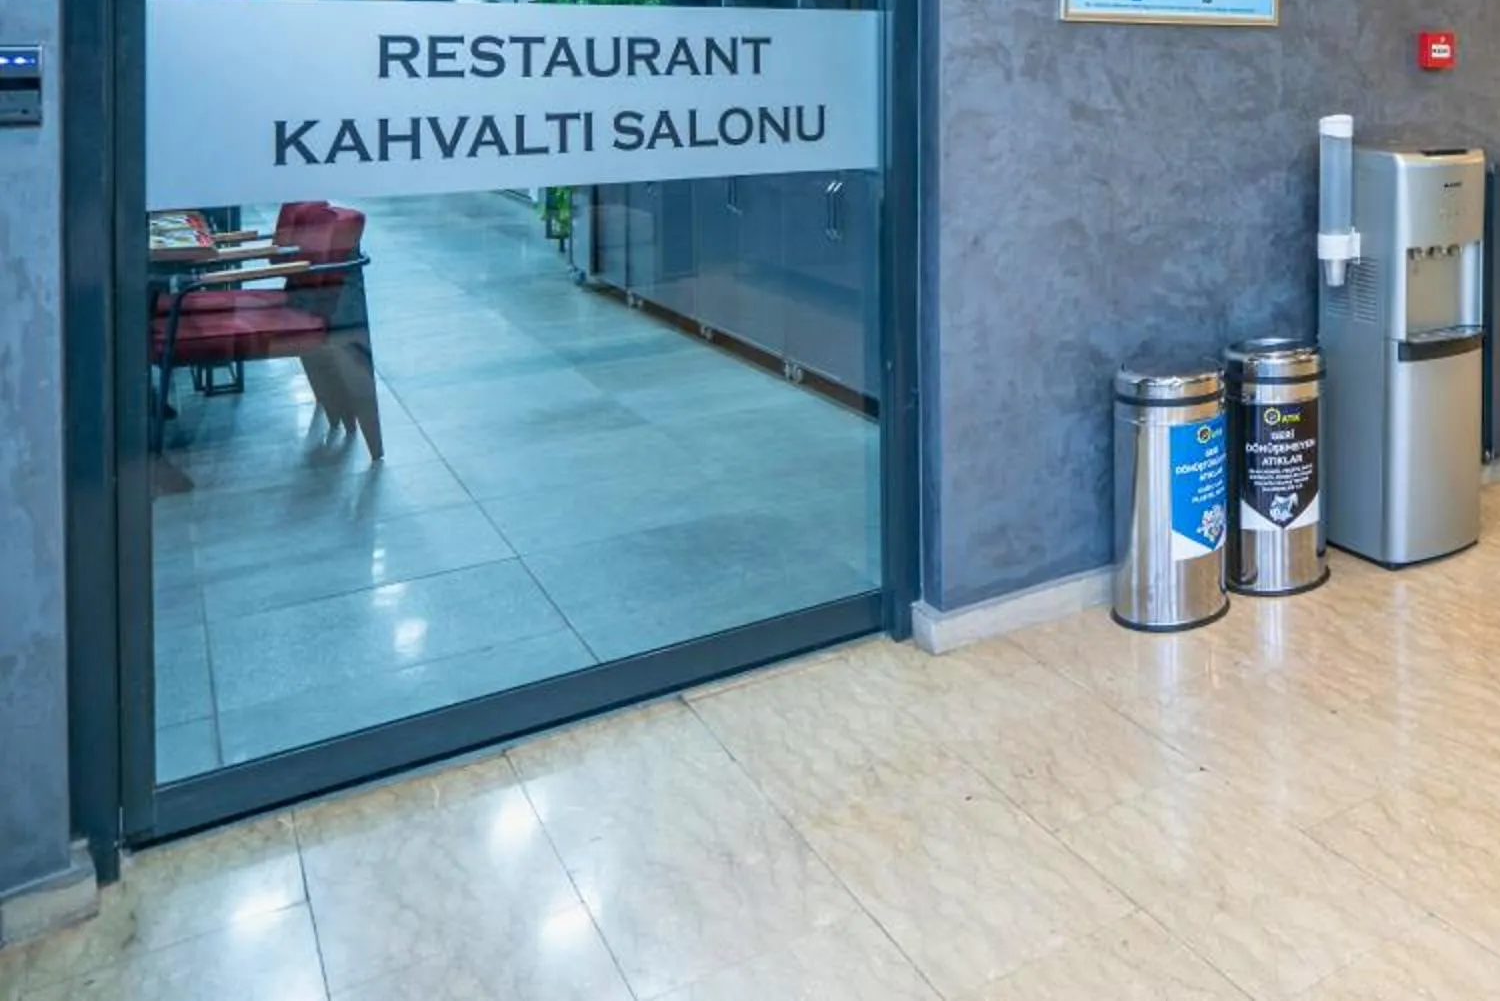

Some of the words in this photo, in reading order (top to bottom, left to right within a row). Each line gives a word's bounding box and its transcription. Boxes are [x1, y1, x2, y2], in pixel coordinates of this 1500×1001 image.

[378, 35, 772, 79] RESTAURANT
[274, 112, 594, 167] KAHVALTI
[612, 104, 826, 151] SALONU
